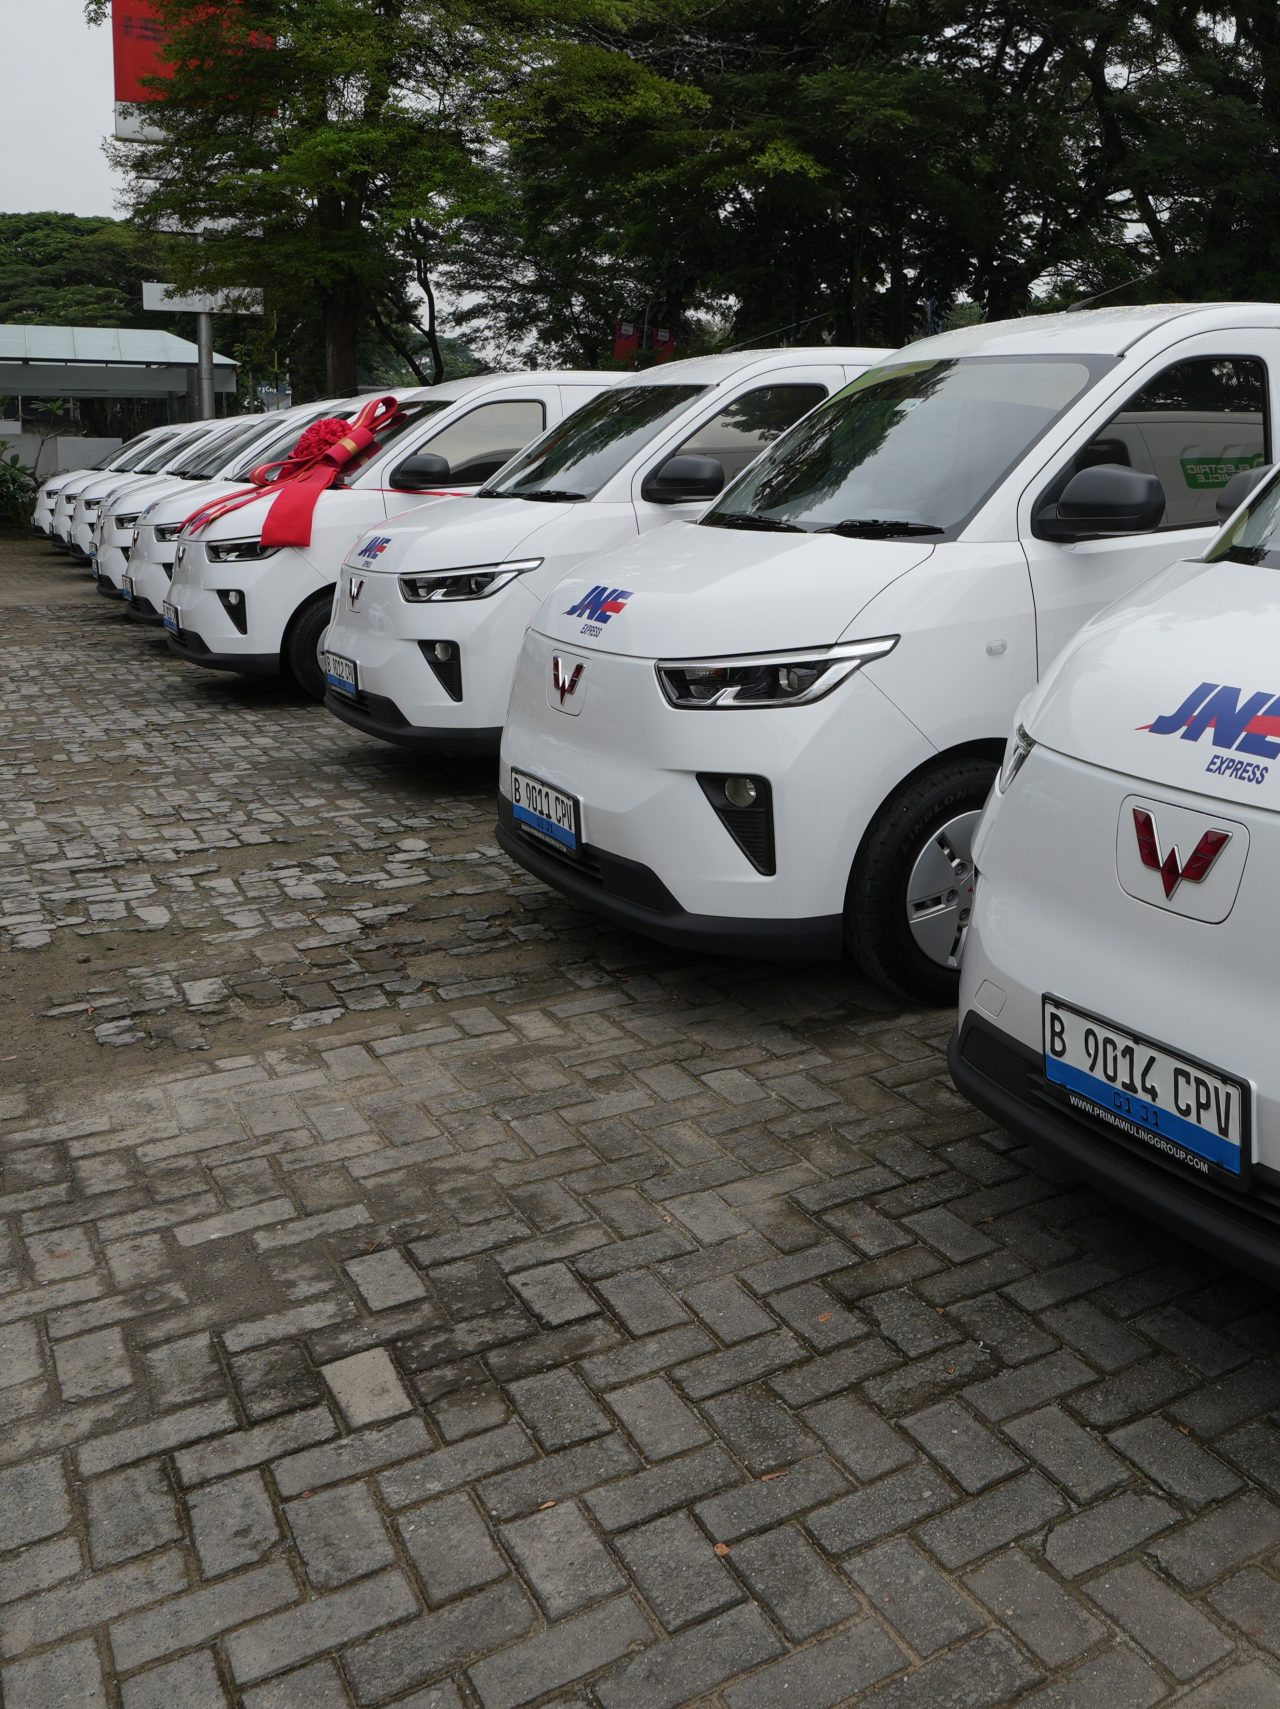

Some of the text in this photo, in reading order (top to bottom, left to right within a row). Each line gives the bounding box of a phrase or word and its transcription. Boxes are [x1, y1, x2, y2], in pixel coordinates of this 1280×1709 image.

[562, 585, 635, 624] JNE
[1205, 754, 1269, 785] EXPRESS
[514, 776, 522, 804] B
[525, 782, 553, 820] 9011
[1050, 1011, 1232, 1139] B 9014 CPV
[1069, 1094, 1209, 1174] WWW.PRIMAWULINGGROUP.COM
